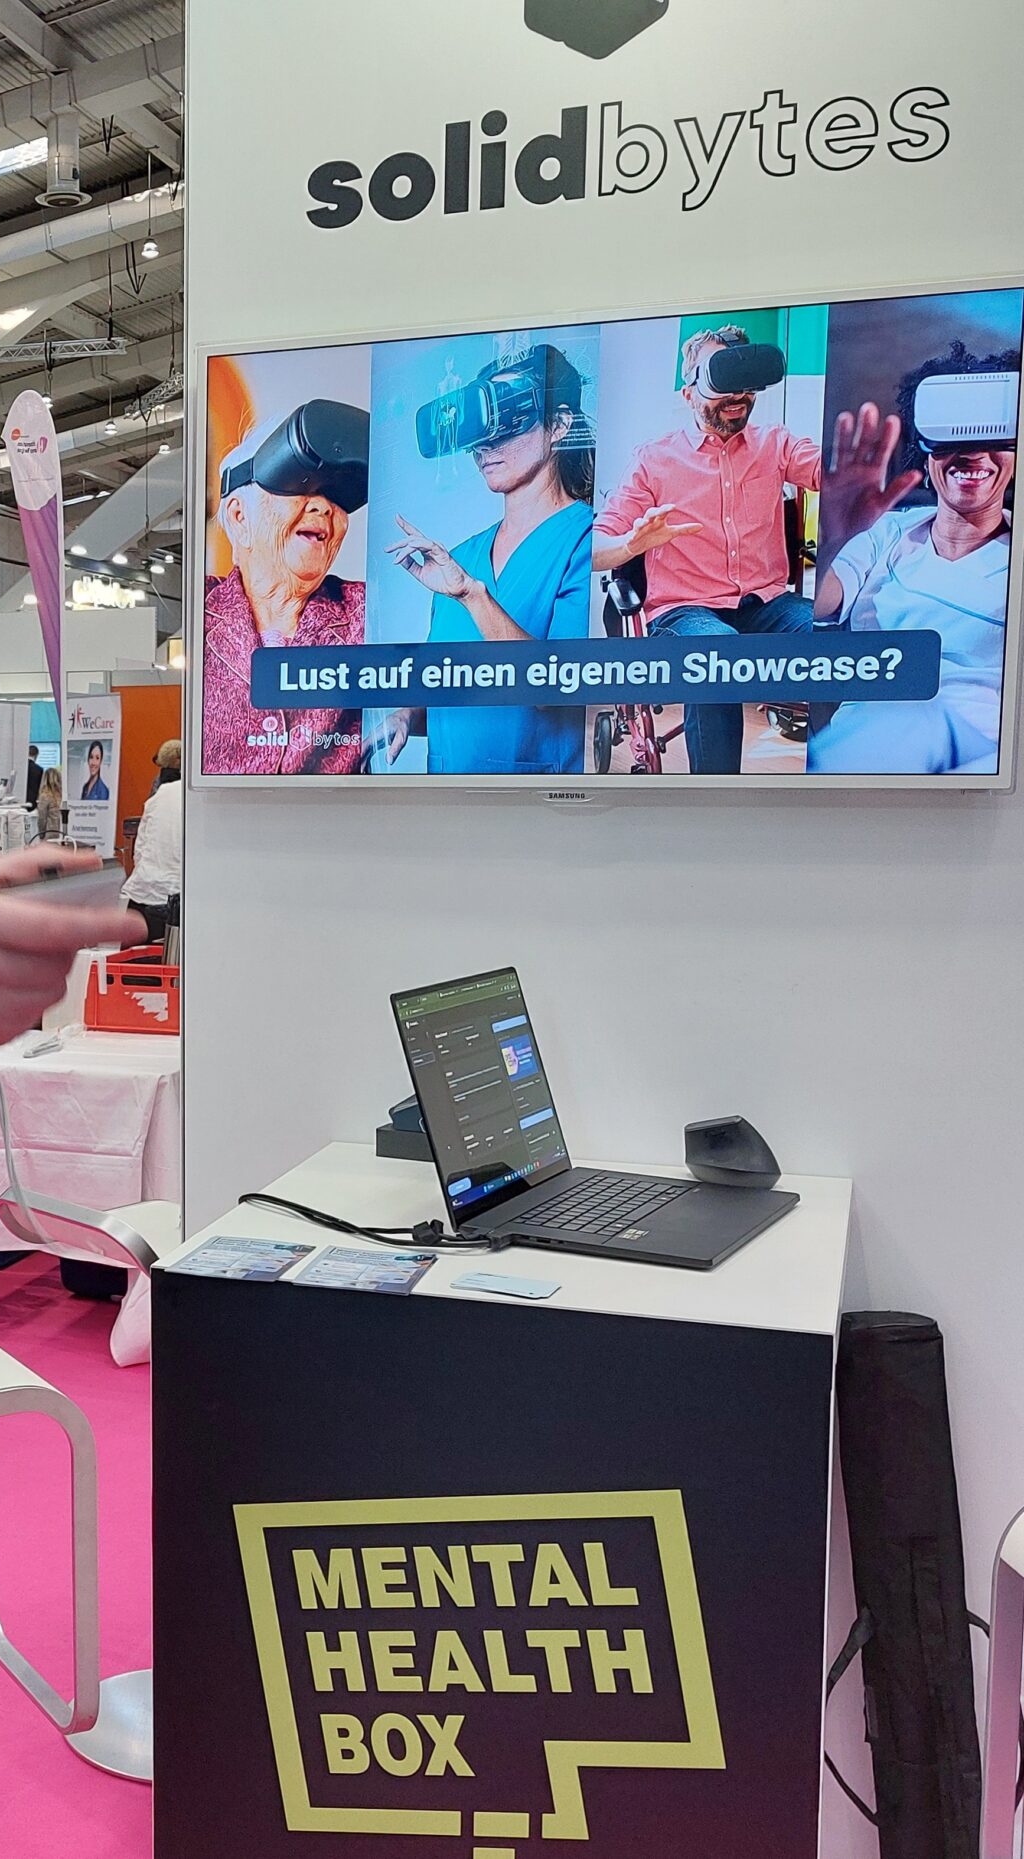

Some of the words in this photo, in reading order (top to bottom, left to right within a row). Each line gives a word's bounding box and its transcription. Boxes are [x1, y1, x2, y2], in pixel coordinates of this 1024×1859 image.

[306, 86, 950, 229] solidbytes
[279, 662, 350, 691] Lust
[358, 657, 413, 689] auf
[421, 657, 516, 688] einen
[526, 655, 670, 694] eigenen
[682, 647, 903, 683] Showcase?
[81, 716, 114, 729] WeCare
[247, 731, 288, 747] solid
[313, 731, 360, 749] bytes
[291, 1541, 640, 1610] MENTAL
[305, 1629, 654, 1693] HEALTH
[320, 1712, 476, 1777] BOX
